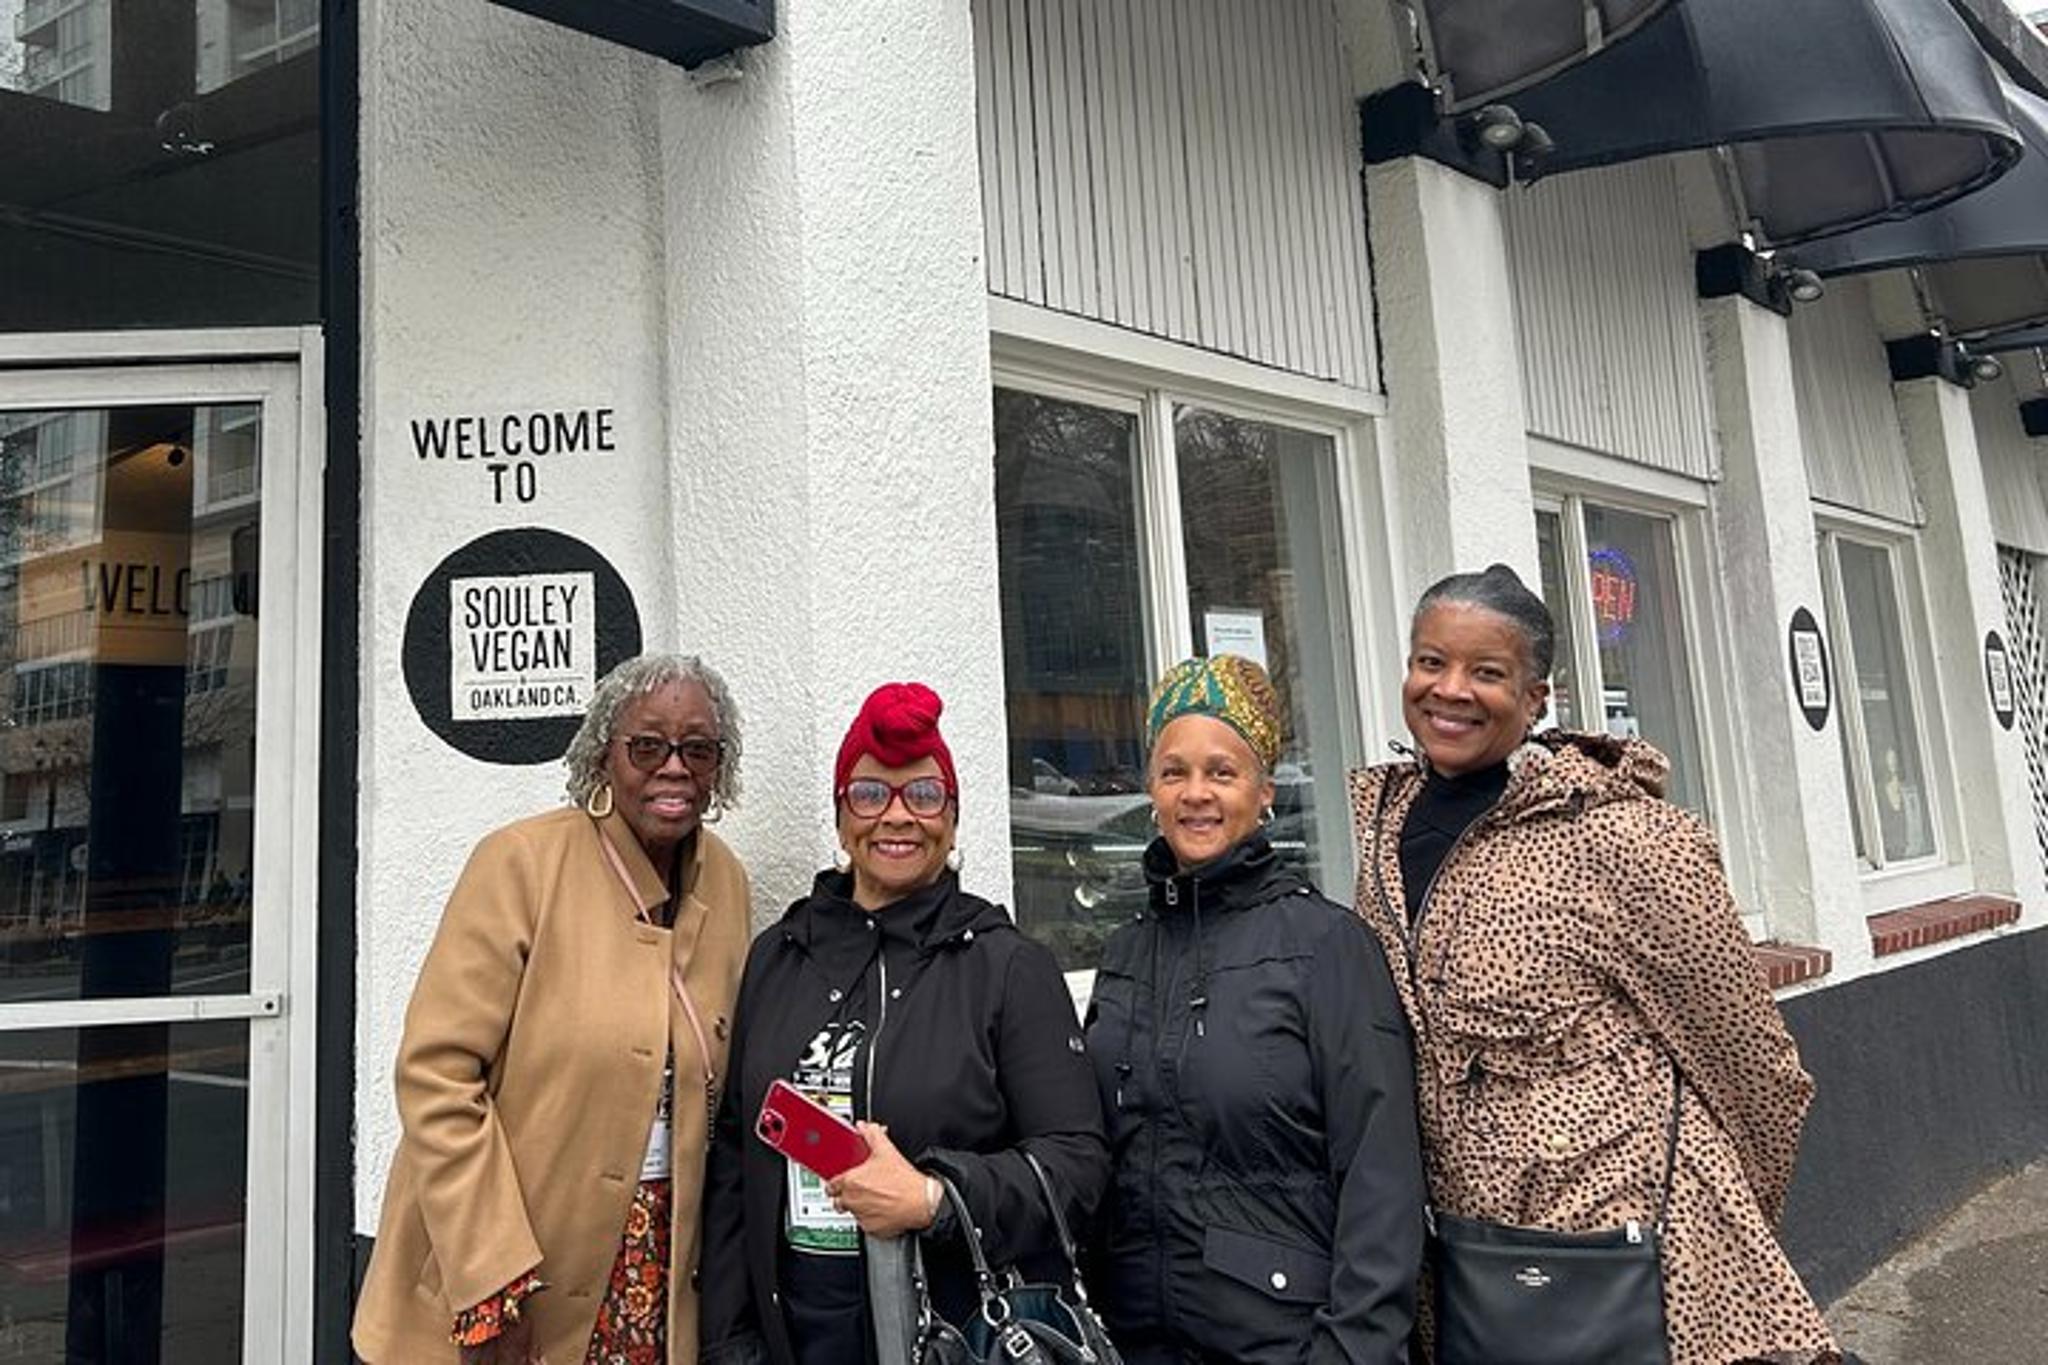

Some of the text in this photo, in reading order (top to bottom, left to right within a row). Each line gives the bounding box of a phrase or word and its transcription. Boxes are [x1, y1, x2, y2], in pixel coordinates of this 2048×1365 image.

[411, 409, 615, 459] WELCOME
[487, 461, 536, 503] TO
[465, 585, 578, 628] SOULEY
[1592, 572, 1636, 621] PEN
[470, 629, 571, 672] VEGAN
[471, 685, 581, 711] OAKLAND CA.
